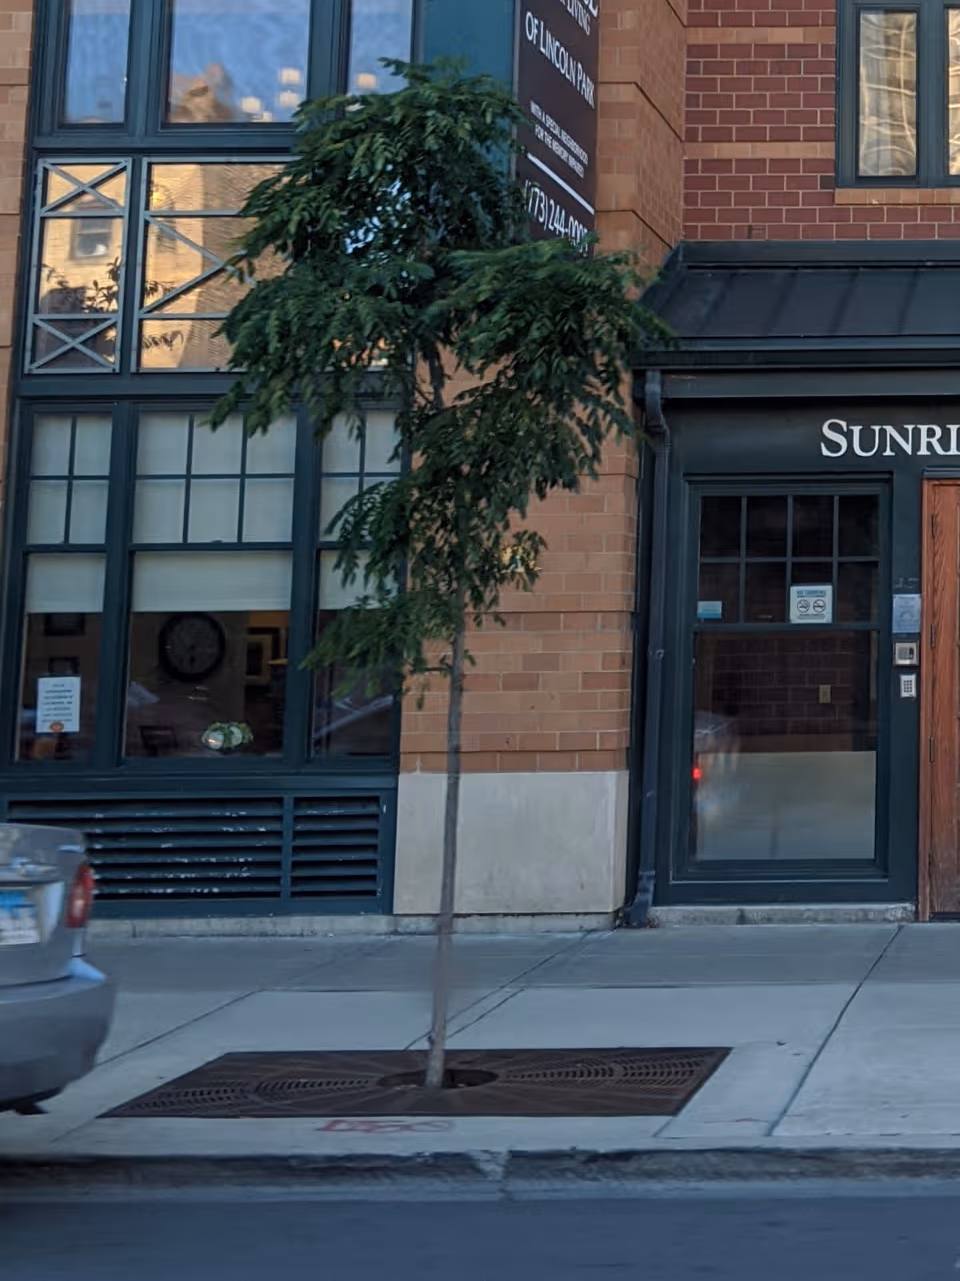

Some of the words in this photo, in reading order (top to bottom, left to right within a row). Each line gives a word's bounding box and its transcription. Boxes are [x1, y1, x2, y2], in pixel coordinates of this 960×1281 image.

[525, 11, 538, 45] OF
[539, 21, 576, 87] LINCOLN
[576, 61, 595, 110] PARK
